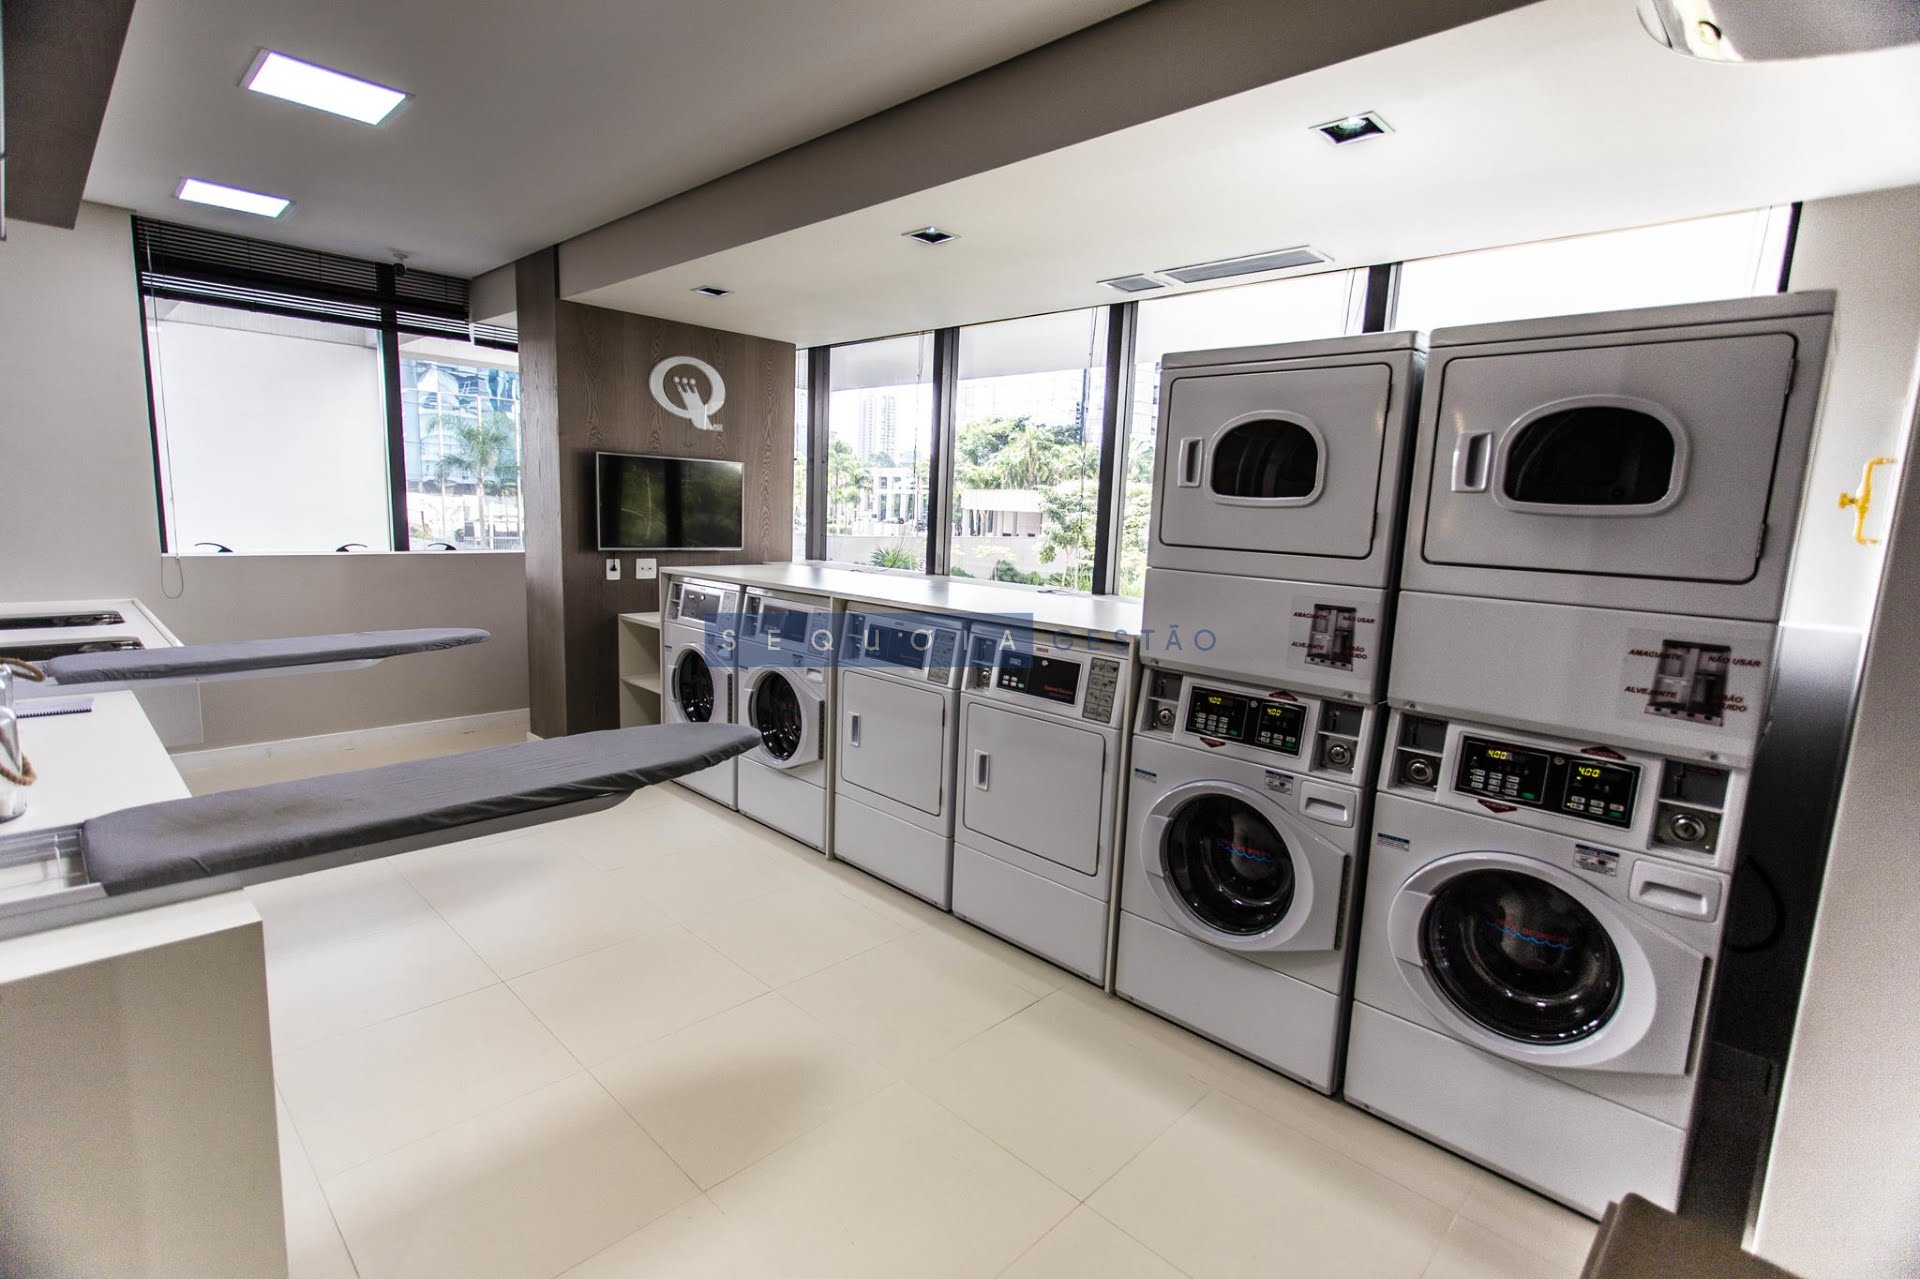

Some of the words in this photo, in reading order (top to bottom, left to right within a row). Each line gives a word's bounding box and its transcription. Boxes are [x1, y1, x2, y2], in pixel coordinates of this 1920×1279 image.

[1357, 616, 1376, 625] USAR
[1291, 641, 1326, 651] ALVEJANTE
[1628, 648, 1683, 661] AMACIANTE
[1708, 655, 1730, 665] NÃO
[1732, 657, 1762, 668] USAR
[1624, 685, 1678, 699] ALVEJANTE
